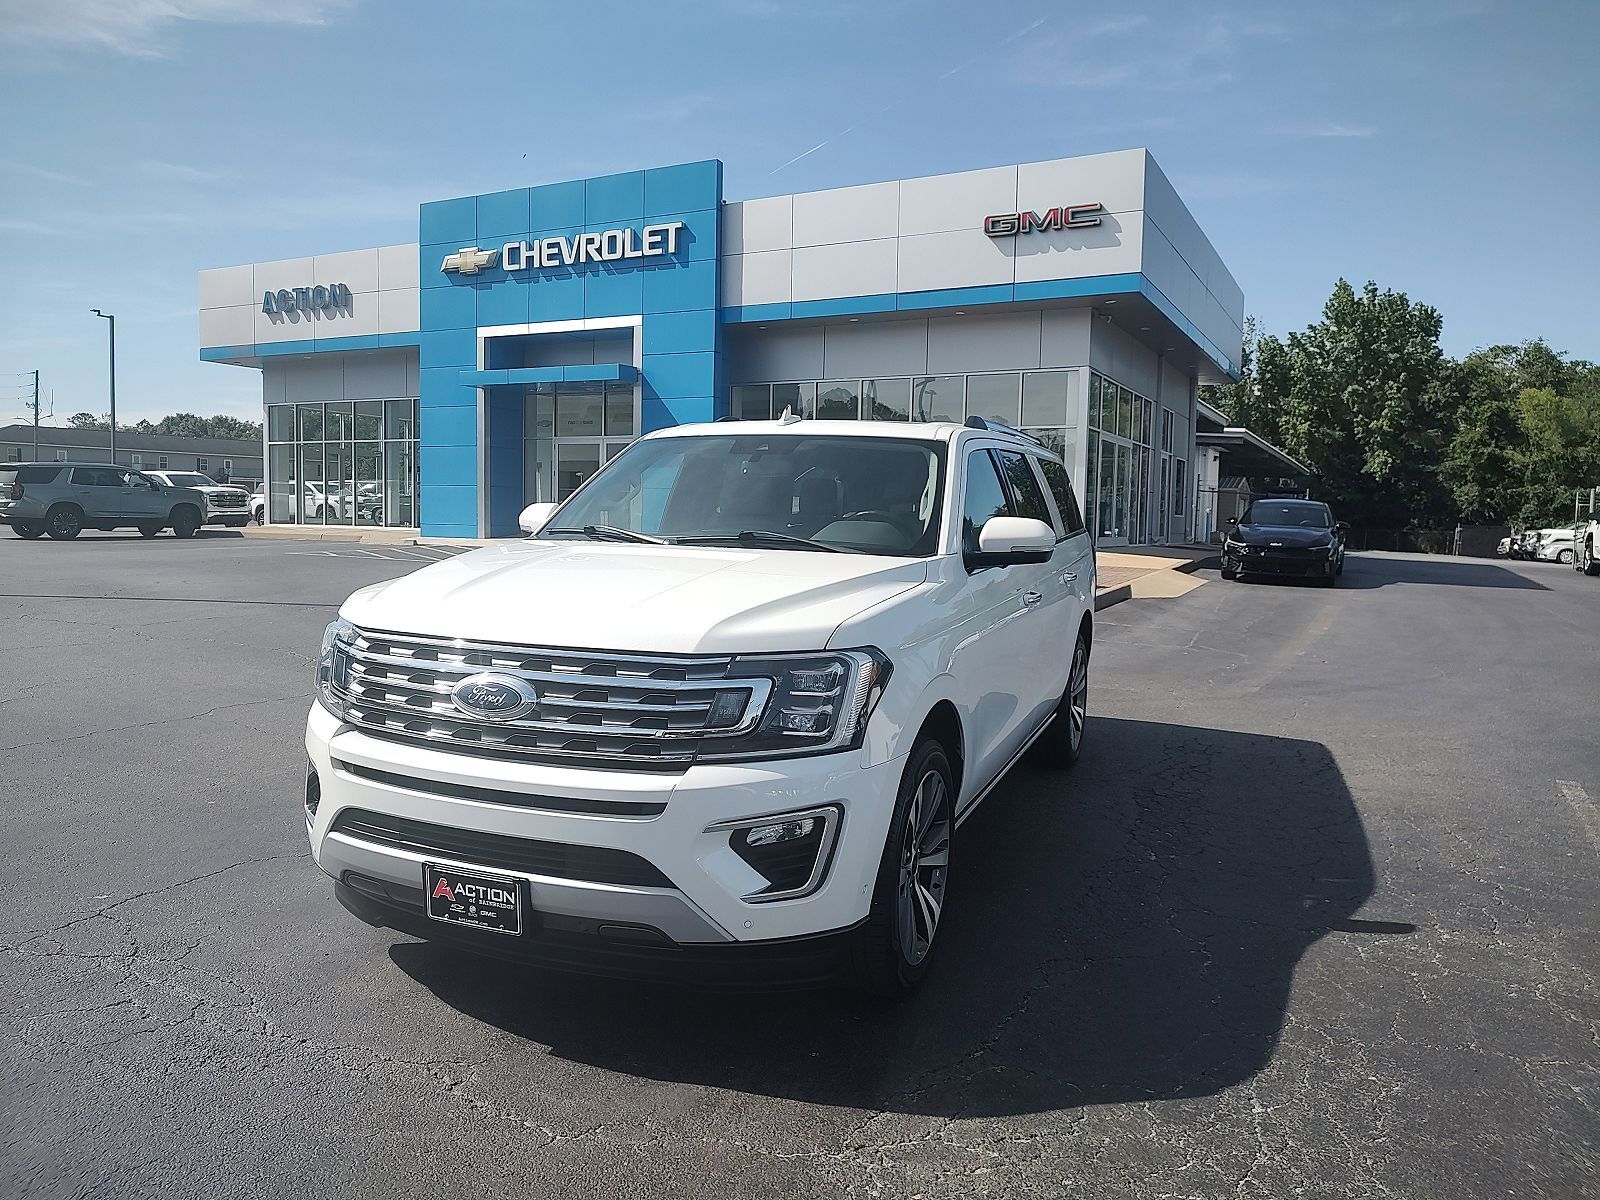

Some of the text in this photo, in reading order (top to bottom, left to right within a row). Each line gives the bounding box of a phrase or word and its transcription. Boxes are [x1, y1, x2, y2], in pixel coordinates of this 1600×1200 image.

[984, 202, 1102, 237] GMC
[502, 222, 684, 271] CHEVROLET
[262, 283, 347, 313] ACTION
[468, 684, 507, 706] Ford
[454, 882, 515, 904] ACTION
[480, 910, 497, 918] GMC
